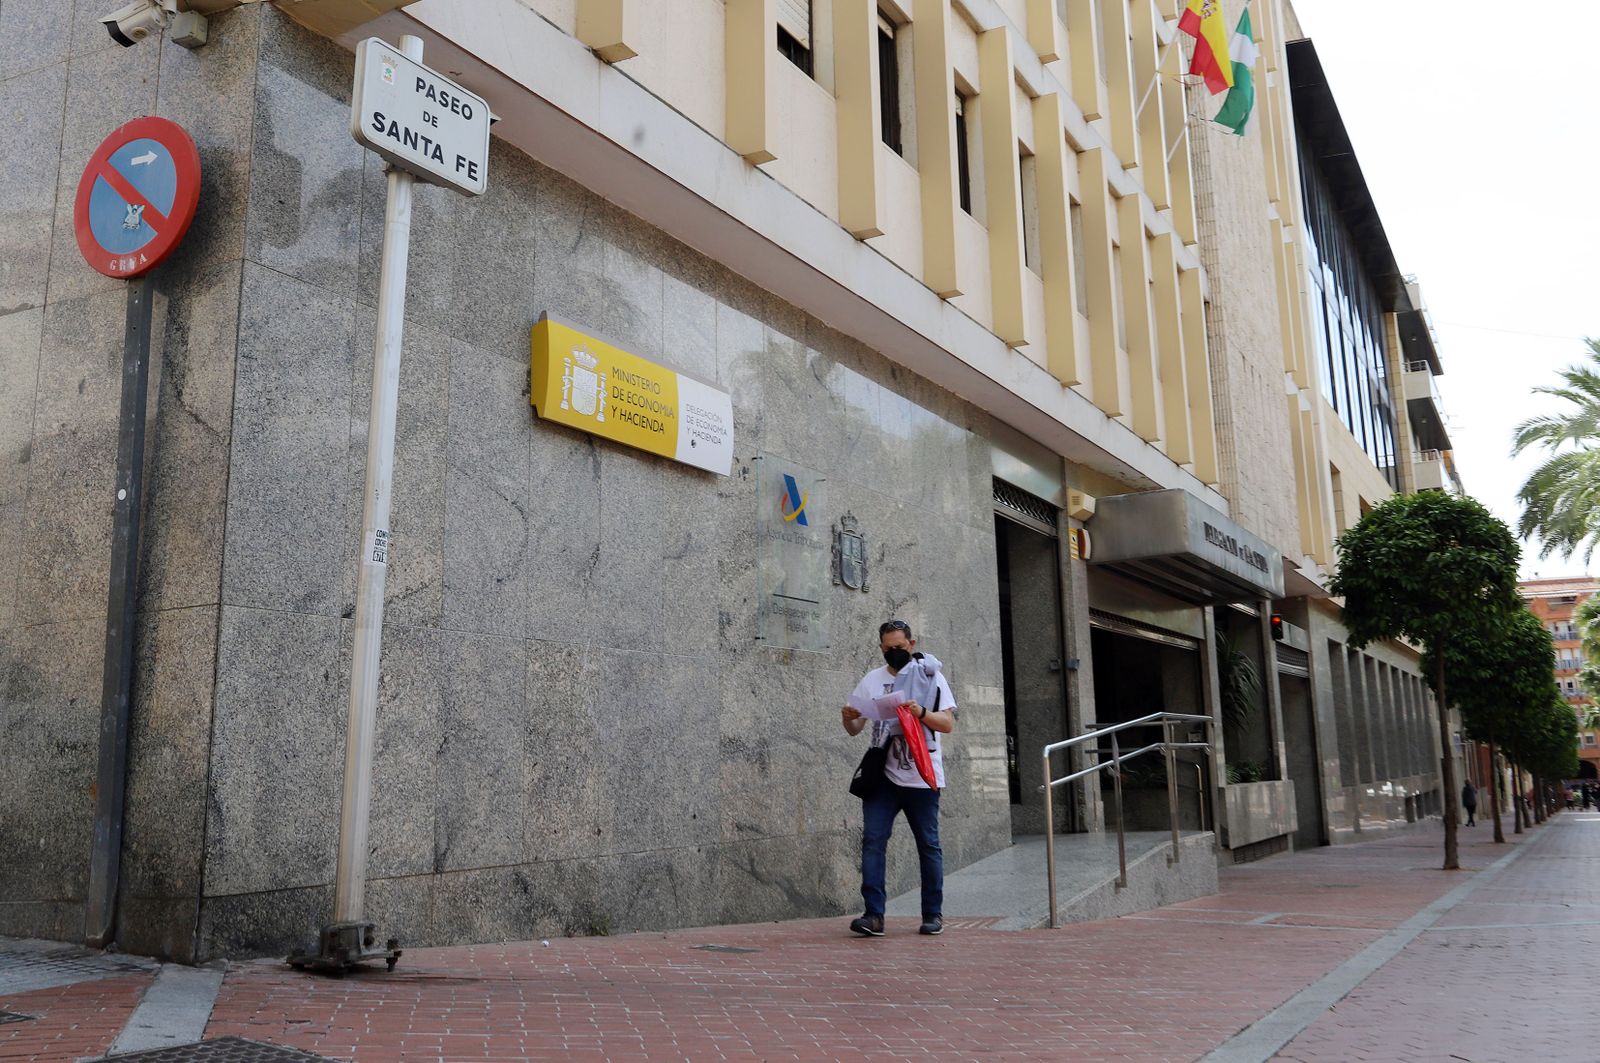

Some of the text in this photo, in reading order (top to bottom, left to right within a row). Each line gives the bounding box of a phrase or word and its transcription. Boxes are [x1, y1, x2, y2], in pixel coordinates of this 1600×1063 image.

[415, 76, 473, 121] PASEO
[422, 110, 438, 129] DE
[371, 111, 478, 182] SANTA FE
[612, 366, 661, 395] MINISTERIO
[612, 385, 624, 401] DE
[611, 405, 665, 434] Y HACIENDA
[686, 415, 694, 425] DE
[692, 429, 721, 444] HACIENDA
